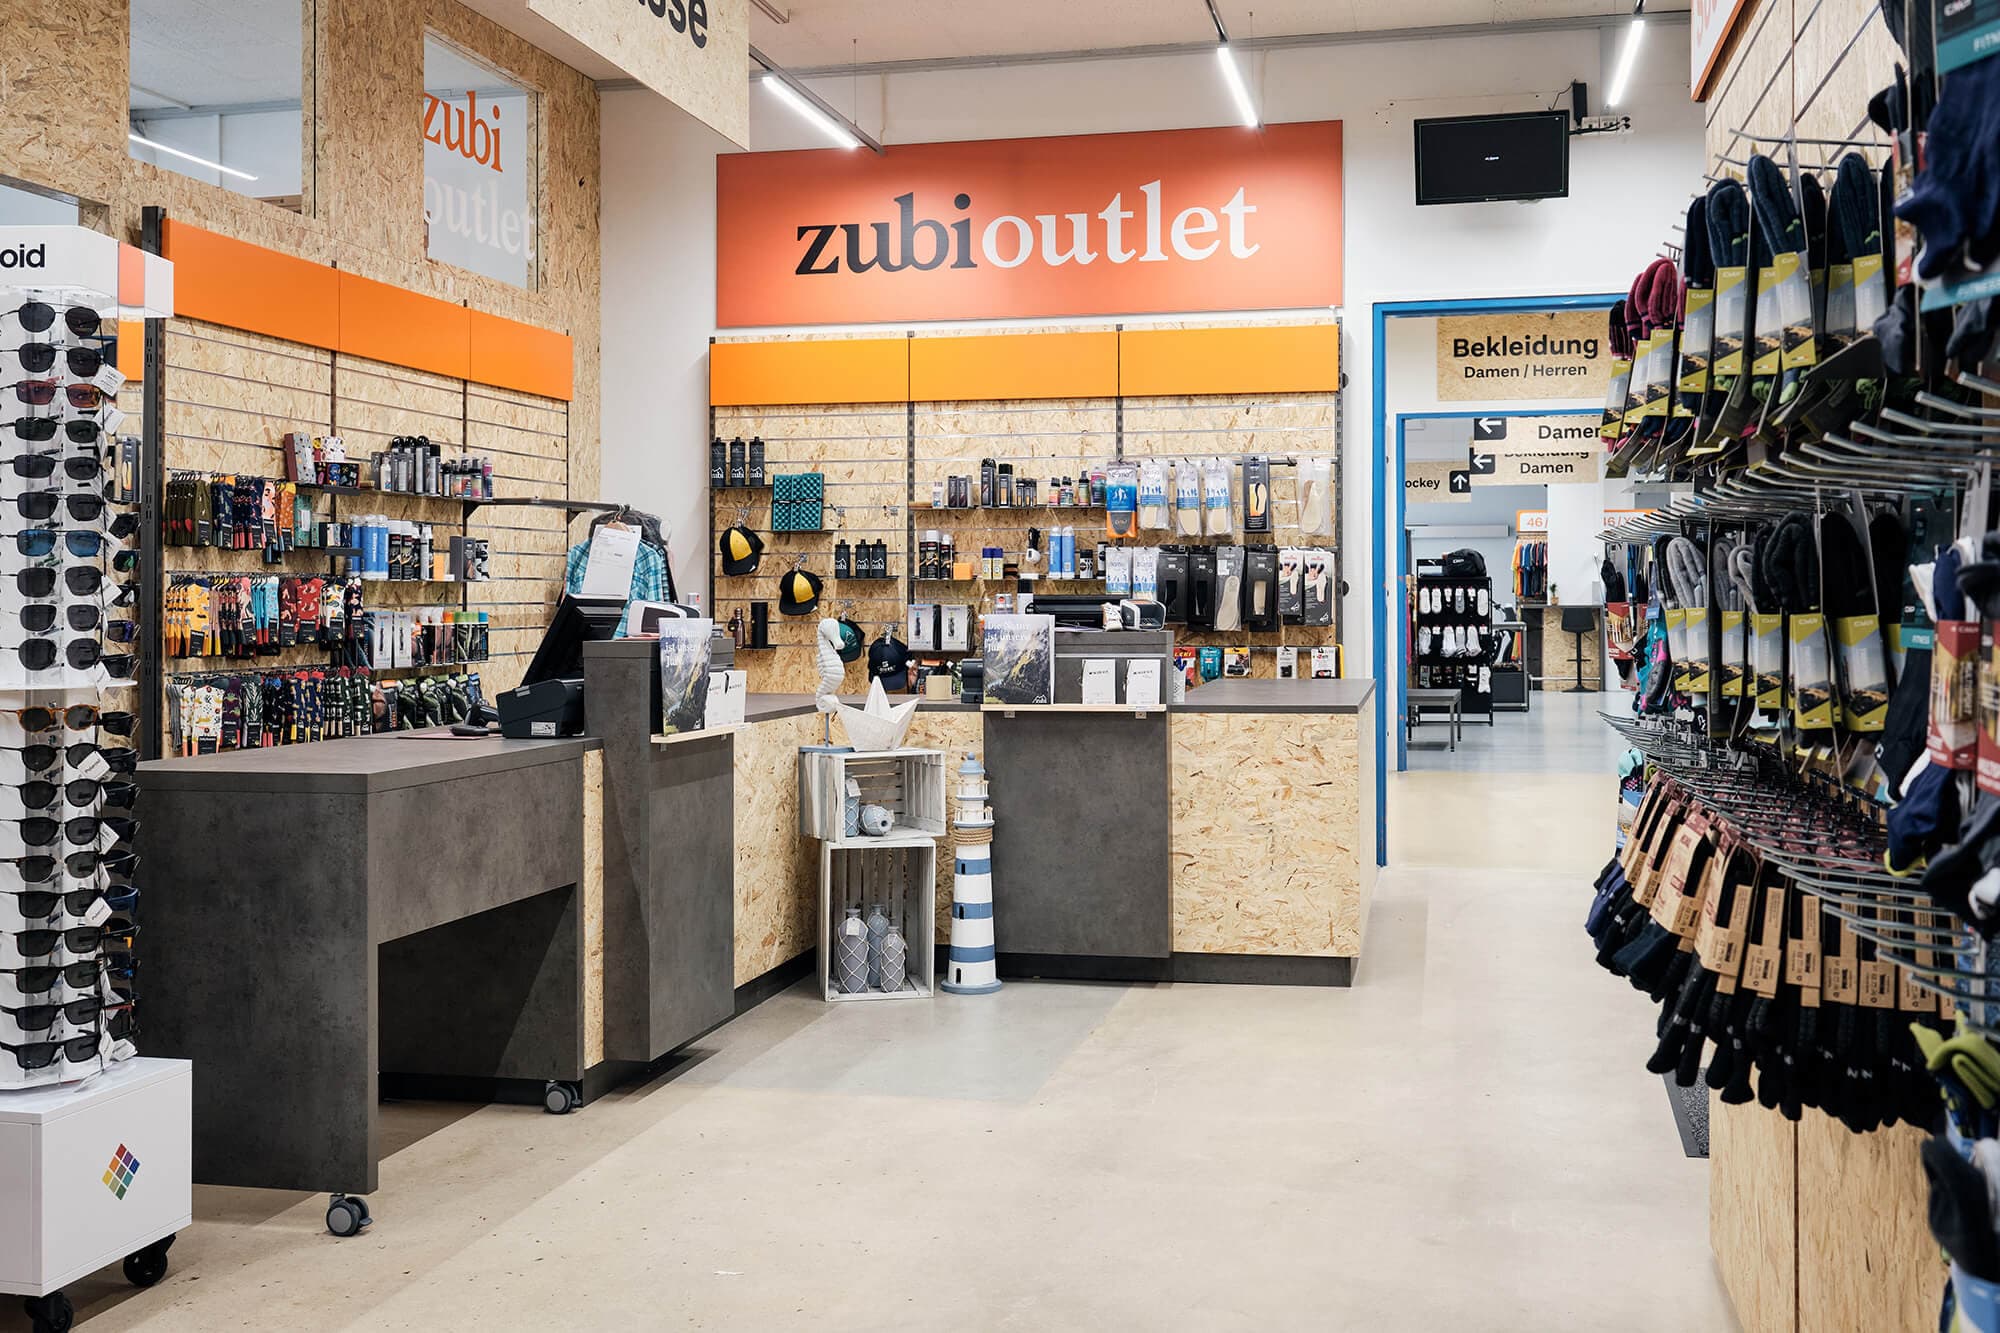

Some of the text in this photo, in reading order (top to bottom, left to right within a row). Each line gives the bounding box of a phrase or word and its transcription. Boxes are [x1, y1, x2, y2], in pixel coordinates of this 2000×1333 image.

[638, 0, 708, 49] se
[424, 90, 503, 173] zubi
[424, 175, 537, 261] outlet
[1453, 334, 1599, 360] Bekleidung
[1464, 366, 1520, 379] Damen
[1533, 364, 1588, 377] Herren
[1520, 462, 1574, 475] Damen
[1405, 477, 1441, 490] ockey
